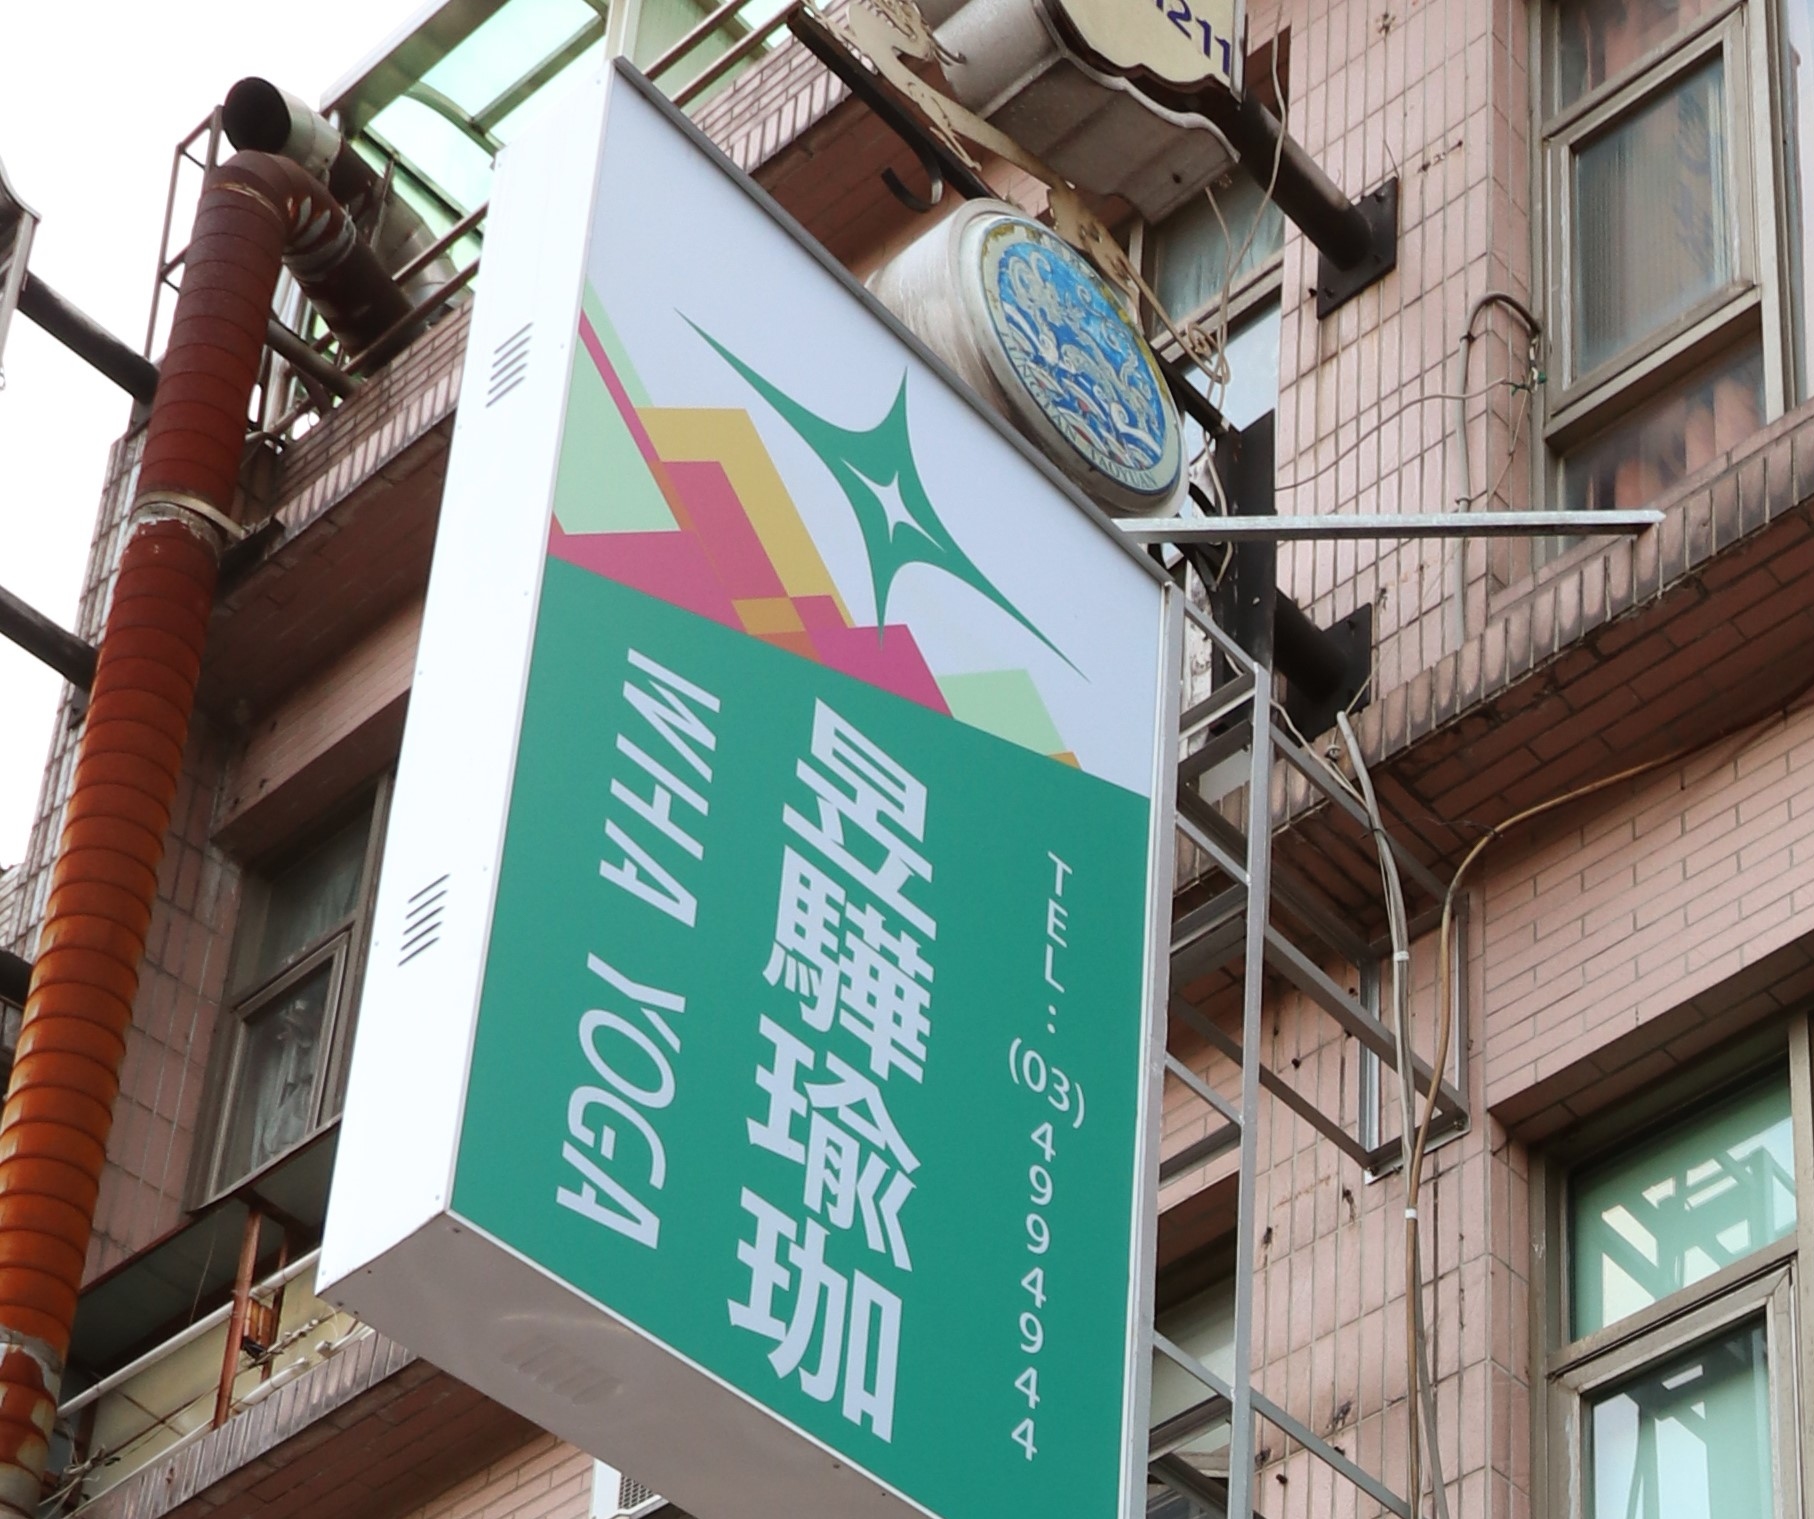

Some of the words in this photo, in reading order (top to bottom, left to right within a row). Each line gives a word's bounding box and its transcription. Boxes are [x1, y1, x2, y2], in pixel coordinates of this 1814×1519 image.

[600, 648, 721, 927] WHA
[556, 953, 686, 1250] YOGA
[727, 698, 937, 1443] 昱驊瑜珈
